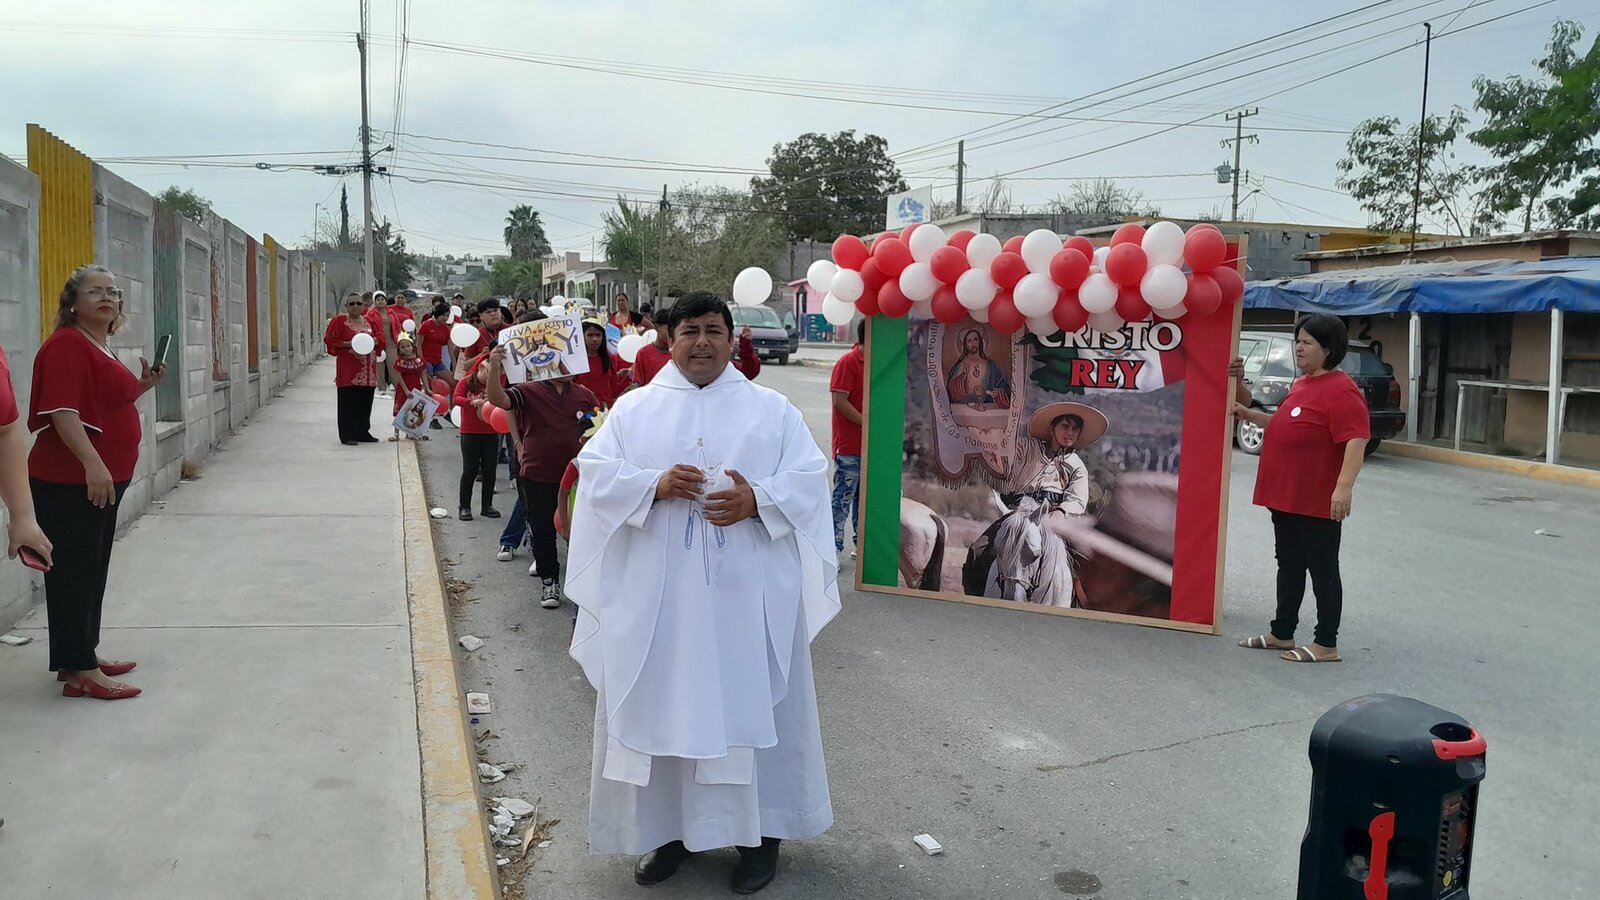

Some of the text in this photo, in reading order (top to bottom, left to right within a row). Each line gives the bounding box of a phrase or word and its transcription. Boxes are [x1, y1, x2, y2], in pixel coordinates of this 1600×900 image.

[537, 318, 573, 331] CRISTO
[1036, 320, 1183, 351] CRISTO
[1070, 359, 1146, 390] REY
